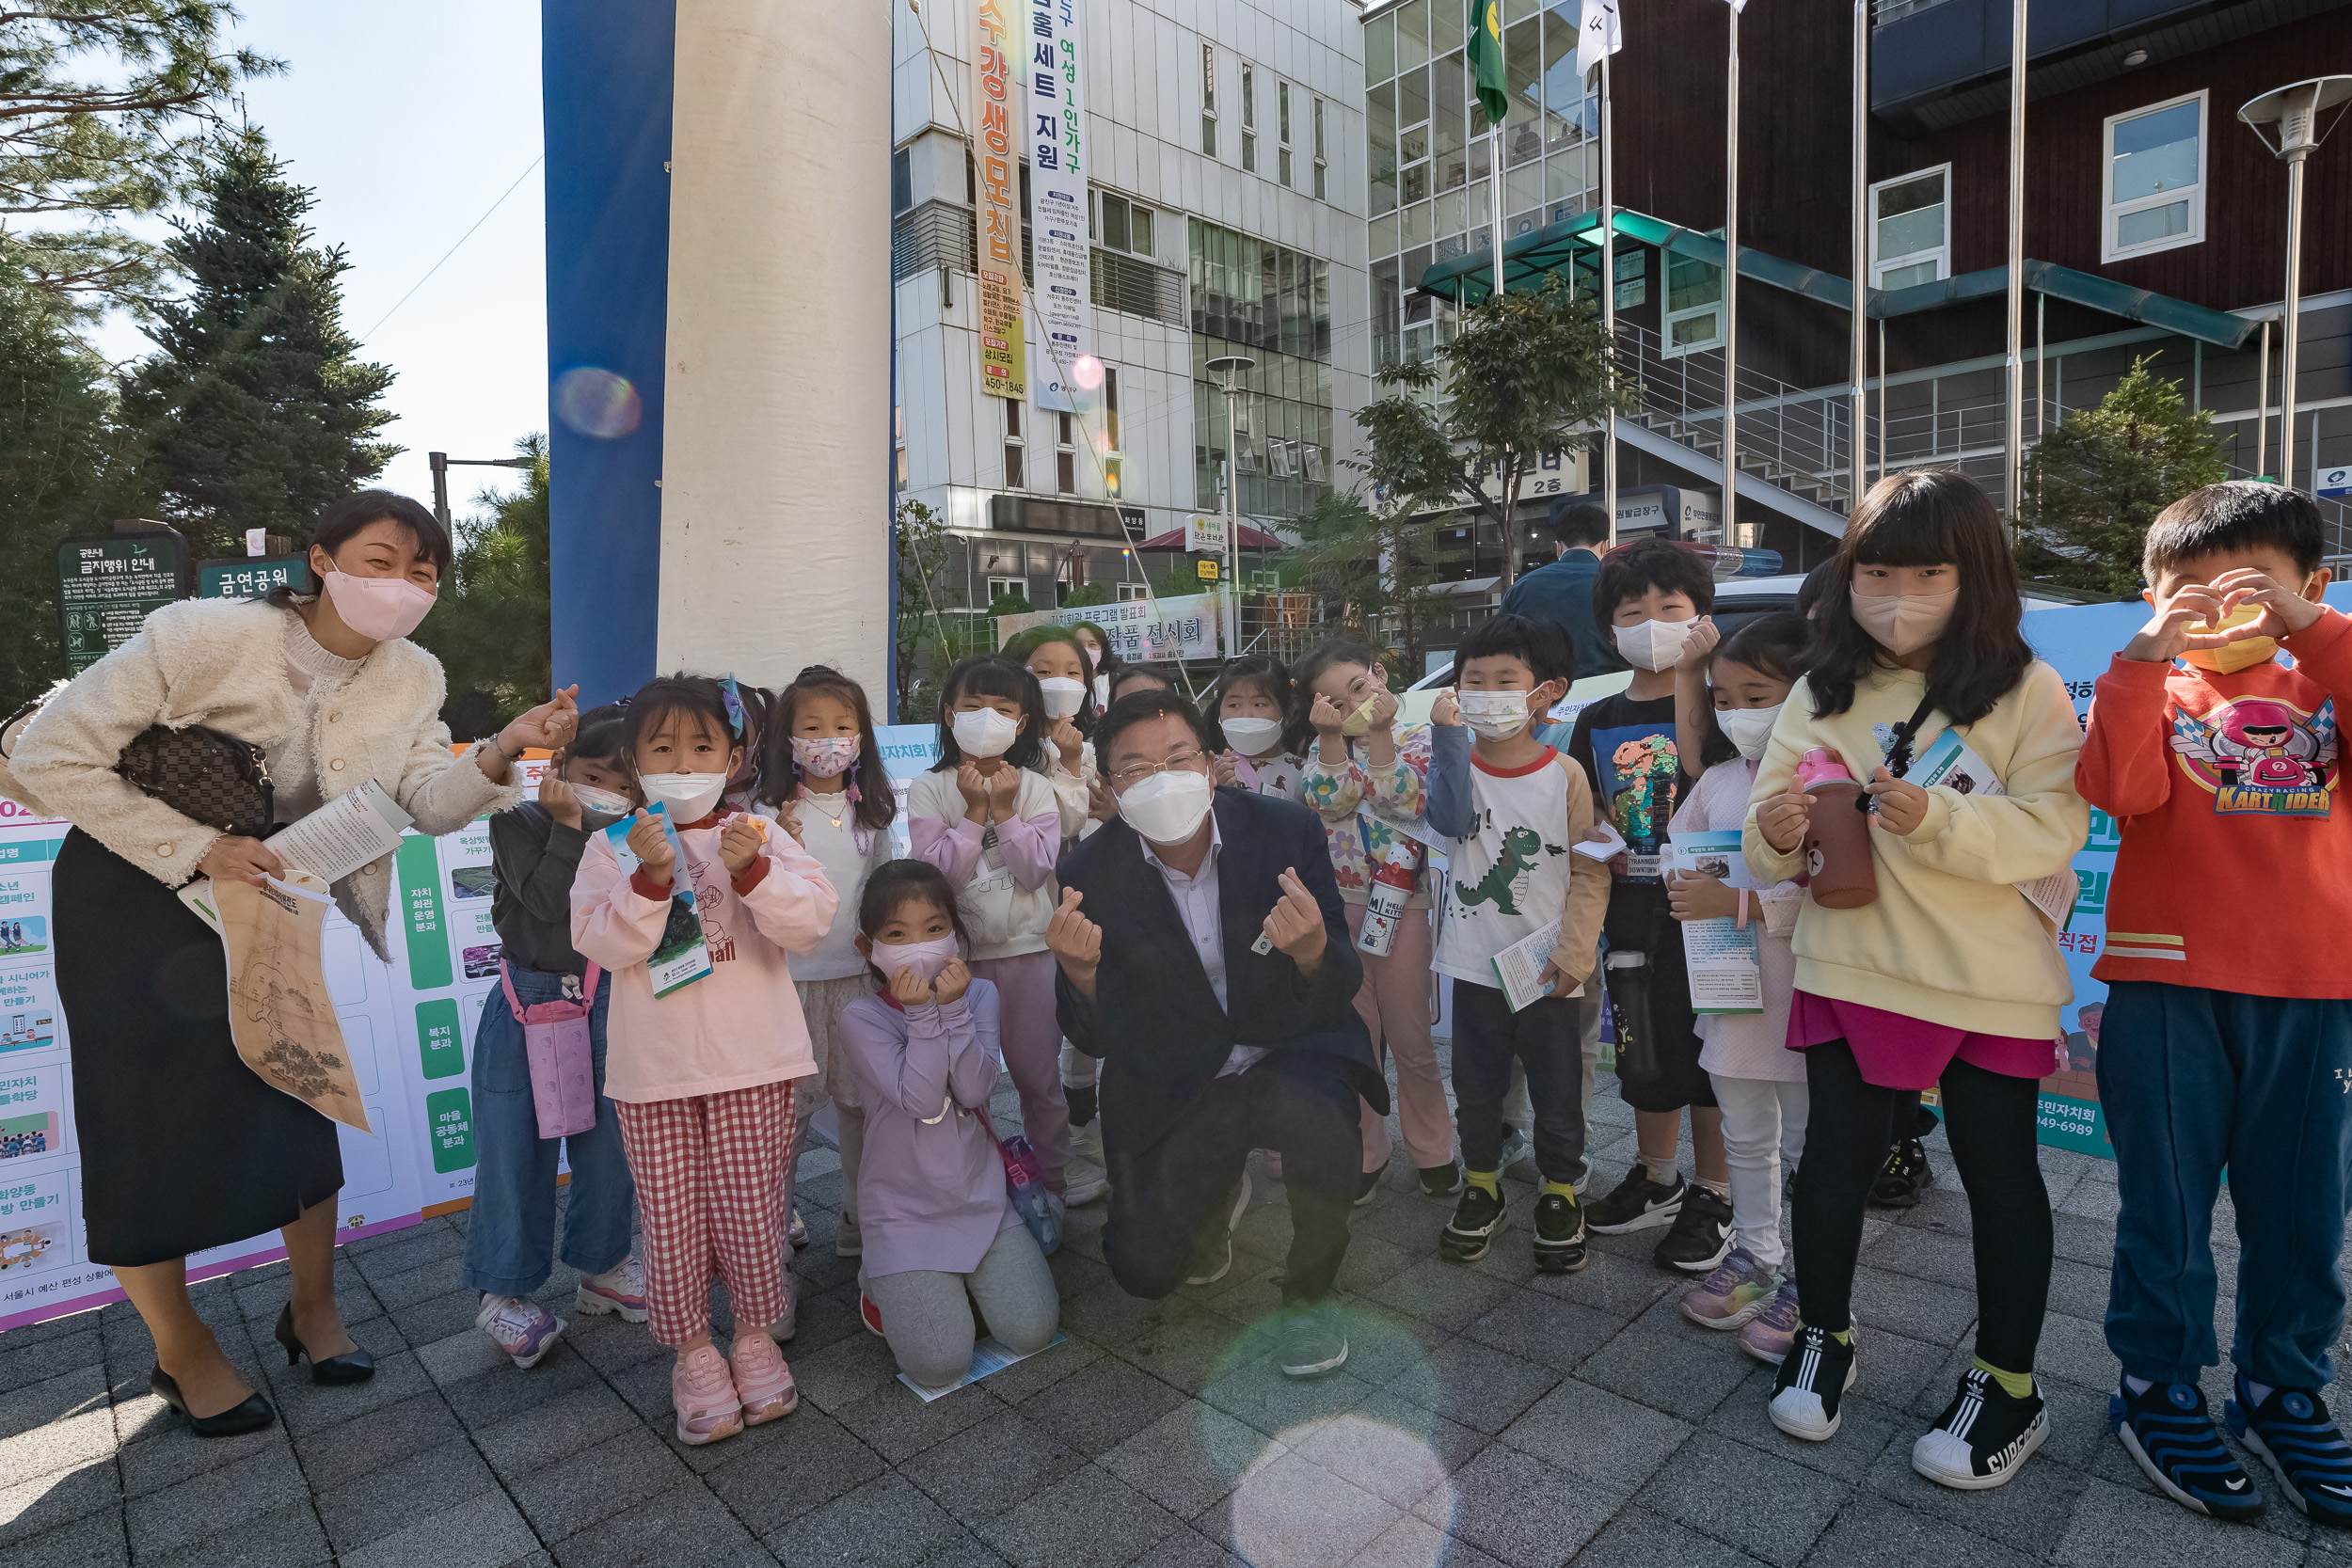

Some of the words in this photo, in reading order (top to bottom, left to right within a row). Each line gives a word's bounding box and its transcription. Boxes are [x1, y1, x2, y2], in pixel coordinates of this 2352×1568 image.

[1060, 39, 1075, 84] 여성
[979, 0, 1011, 263] 수강생모집
[1037, 114, 1058, 170] 지원
[985, 349, 1013, 364] 상시모집
[985, 377, 1024, 394] 450-1845
[1534, 478, 1561, 493] 2층
[81, 560, 127, 574] 금지행위
[132, 558, 155, 571] 안내
[1085, 608, 1118, 622] 프로그램
[1120, 605, 1146, 620] 발표회
[1105, 625, 1140, 649] 작품
[1146, 617, 1201, 646] 전시회
[466, 846, 491, 855] 가꾸기
[411, 888, 432, 897] 자치
[413, 898, 433, 909] 회관
[414, 910, 435, 921] 운영
[415, 921, 436, 932] 분과
[8, 971, 50, 983] 시니어가
[4, 995, 35, 1006] 만들기
[429, 1025, 451, 1037] 복지
[430, 1037, 452, 1050] 분과
[440, 1110, 462, 1122] 마을
[436, 1120, 469, 1137] 공동체
[443, 1135, 465, 1148] 분과
[20, 1194, 58, 1212] 만들기
[4, 1288, 34, 1301] 서울시
[39, 1281, 57, 1293] 예산
[62, 1276, 81, 1288] 편성
